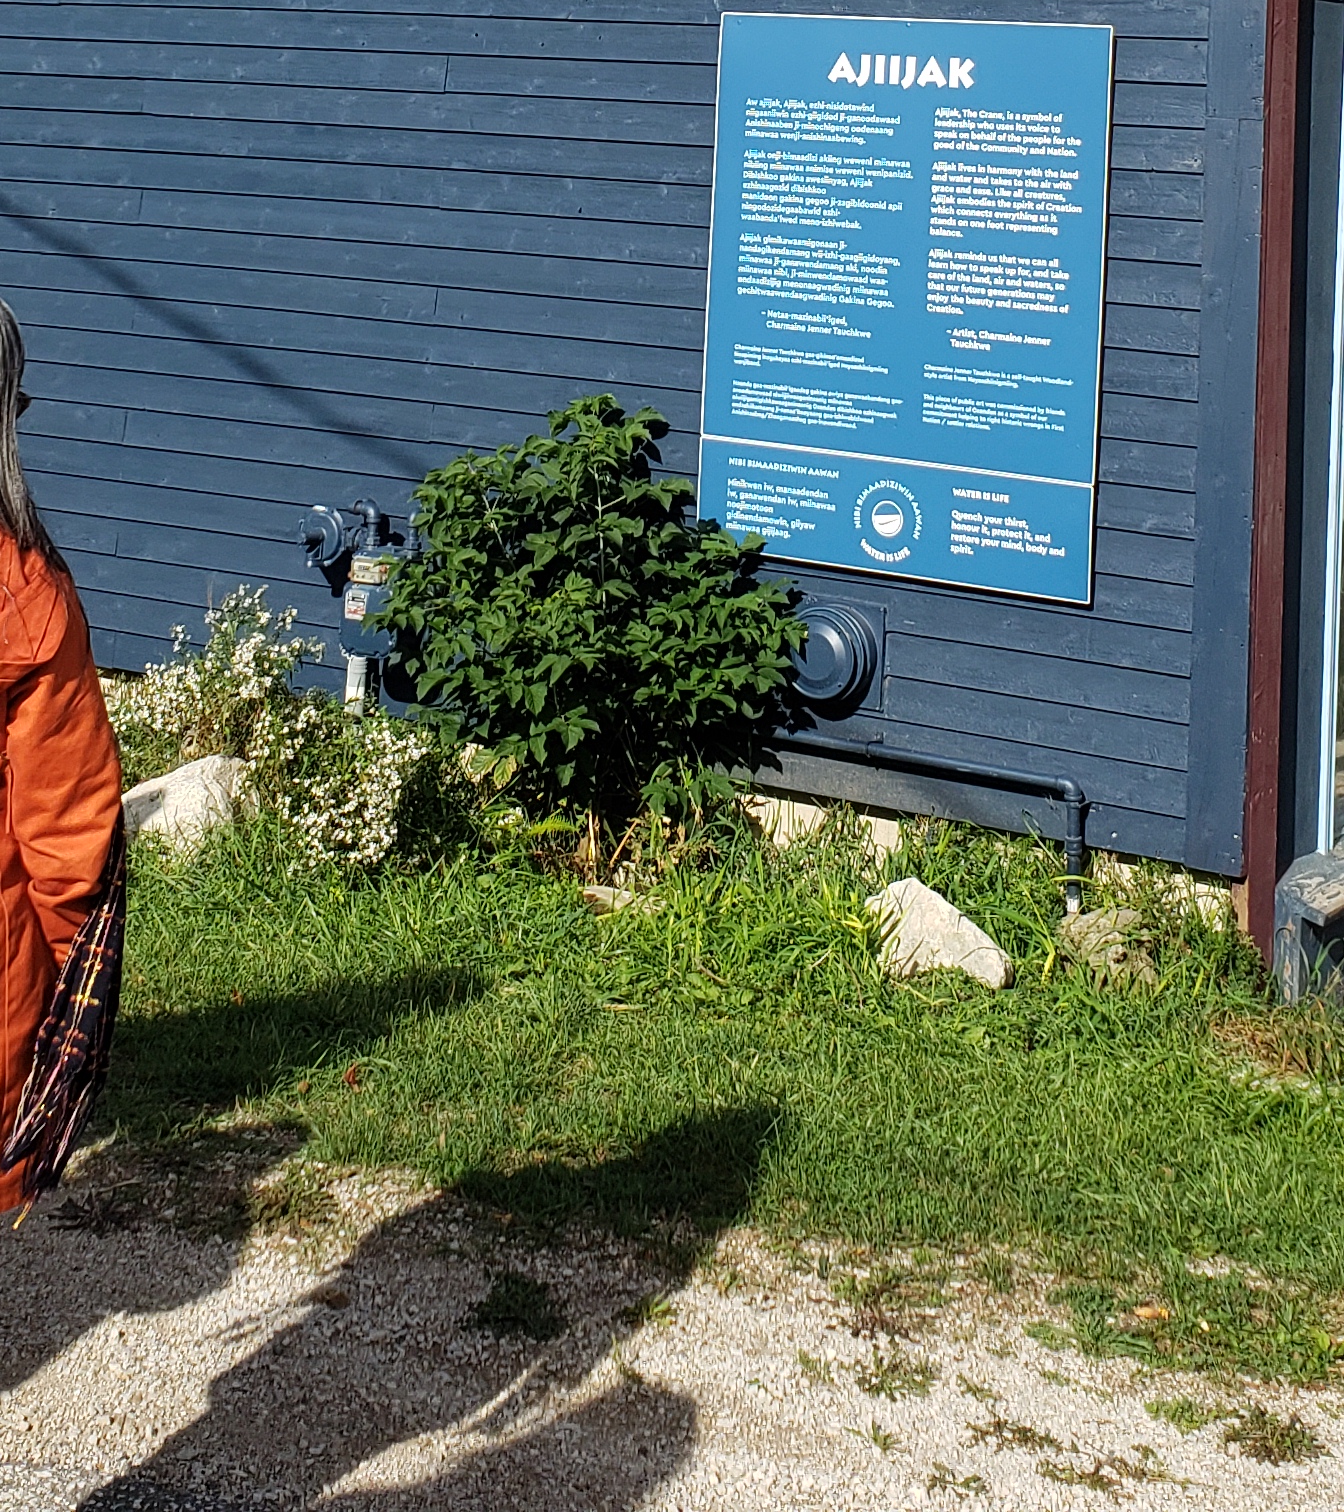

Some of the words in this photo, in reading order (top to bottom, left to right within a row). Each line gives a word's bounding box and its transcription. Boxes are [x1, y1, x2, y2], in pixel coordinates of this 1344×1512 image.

[827, 51, 975, 90] AJIIJAK
[961, 108, 978, 118] The
[1021, 112, 1052, 123] symbol
[1053, 113, 1063, 123] of
[934, 116, 976, 130] leadership
[976, 120, 995, 130] who
[995, 123, 1014, 131] uses
[1015, 122, 1026, 132] its
[1027, 123, 1050, 133] voice
[1050, 125, 1061, 134] to
[933, 129, 958, 139] speak
[958, 132, 970, 140] on
[970, 130, 997, 141] behalf
[996, 132, 1007, 142] of
[1007, 132, 1022, 143] the
[1022, 134, 1052, 145] people
[1052, 134, 1066, 145] for
[1066, 136, 1082, 146] the
[933, 138, 955, 150] good
[955, 140, 965, 150] of
[965, 140, 980, 151] the
[980, 142, 1028, 156] Community
[1029, 144, 1046, 155] and
[957, 162, 976, 173] lives
[986, 164, 1023, 178] harmony
[1023, 166, 1043, 177] with
[1044, 168, 1059, 179] the
[1059, 169, 1079, 180] land
[931, 172, 948, 182] and
[948, 174, 973, 183] water
[973, 175, 989, 185] and
[990, 176, 1012, 186] takes
[1013, 176, 1023, 187] to
[1024, 178, 1039, 188] the
[1039, 179, 1051, 189] air
[1052, 180, 1072, 190] with
[931, 184, 954, 193] grace
[955, 184, 971, 195] and
[994, 187, 1012, 197] Like
[1012, 188, 1023, 198] all
[930, 204, 955, 215] which
[955, 208, 993, 218] connects
[993, 210, 1038, 223] everything
[1039, 214, 1049, 222] as
[956, 196, 996, 207] embodies
[996, 198, 1012, 208] the
[1012, 199, 1034, 210] spirit
[1035, 201, 1045, 211] of
[1045, 202, 1083, 213] Creation
[929, 216, 957, 226] stands
[957, 219, 968, 227] on
[969, 220, 986, 229] one
[986, 219, 1005, 230] foot
[1005, 223, 1058, 236] representing
[953, 250, 987, 262] reminds
[987, 255, 998, 263] us
[998, 253, 1017, 264] that
[1017, 257, 1030, 266] we
[1031, 258, 1047, 267] can
[1048, 258, 1059, 268] all
[927, 258, 949, 270] learn
[949, 260, 968, 271] how
[968, 263, 978, 272] to
[979, 264, 1004, 274] speak
[1004, 267, 1016, 277] up
[1032, 268, 1049, 278] and
[1050, 269, 1070, 280] take
[927, 271, 946, 280] care
[946, 271, 956, 281] of
[956, 272, 971, 283] the
[993, 275, 1005, 286] air
[1005, 277, 1022, 287] and
[1054, 282, 1066, 291] so
[927, 280, 945, 291] that
[945, 284, 960, 293] our
[960, 283, 986, 295] future
[986, 288, 1036, 300] generations
[1036, 292, 1055, 303] may
[926, 292, 949, 304] enjoy
[950, 293, 964, 304] the
[965, 294, 994, 308] beauty
[995, 298, 1011, 309] and
[1058, 304, 1069, 314] of
[952, 487, 982, 500] WATER
[991, 492, 1010, 504] LIFE
[951, 509, 983, 522] Quench
[983, 515, 1003, 525] your
[950, 519, 980, 533] honour
[991, 528, 1023, 540] protect
[1034, 533, 1051, 544] and
[950, 533, 980, 546] restore
[980, 537, 1000, 548] your
[1025, 541, 1048, 556] body
[1048, 546, 1065, 557] and
